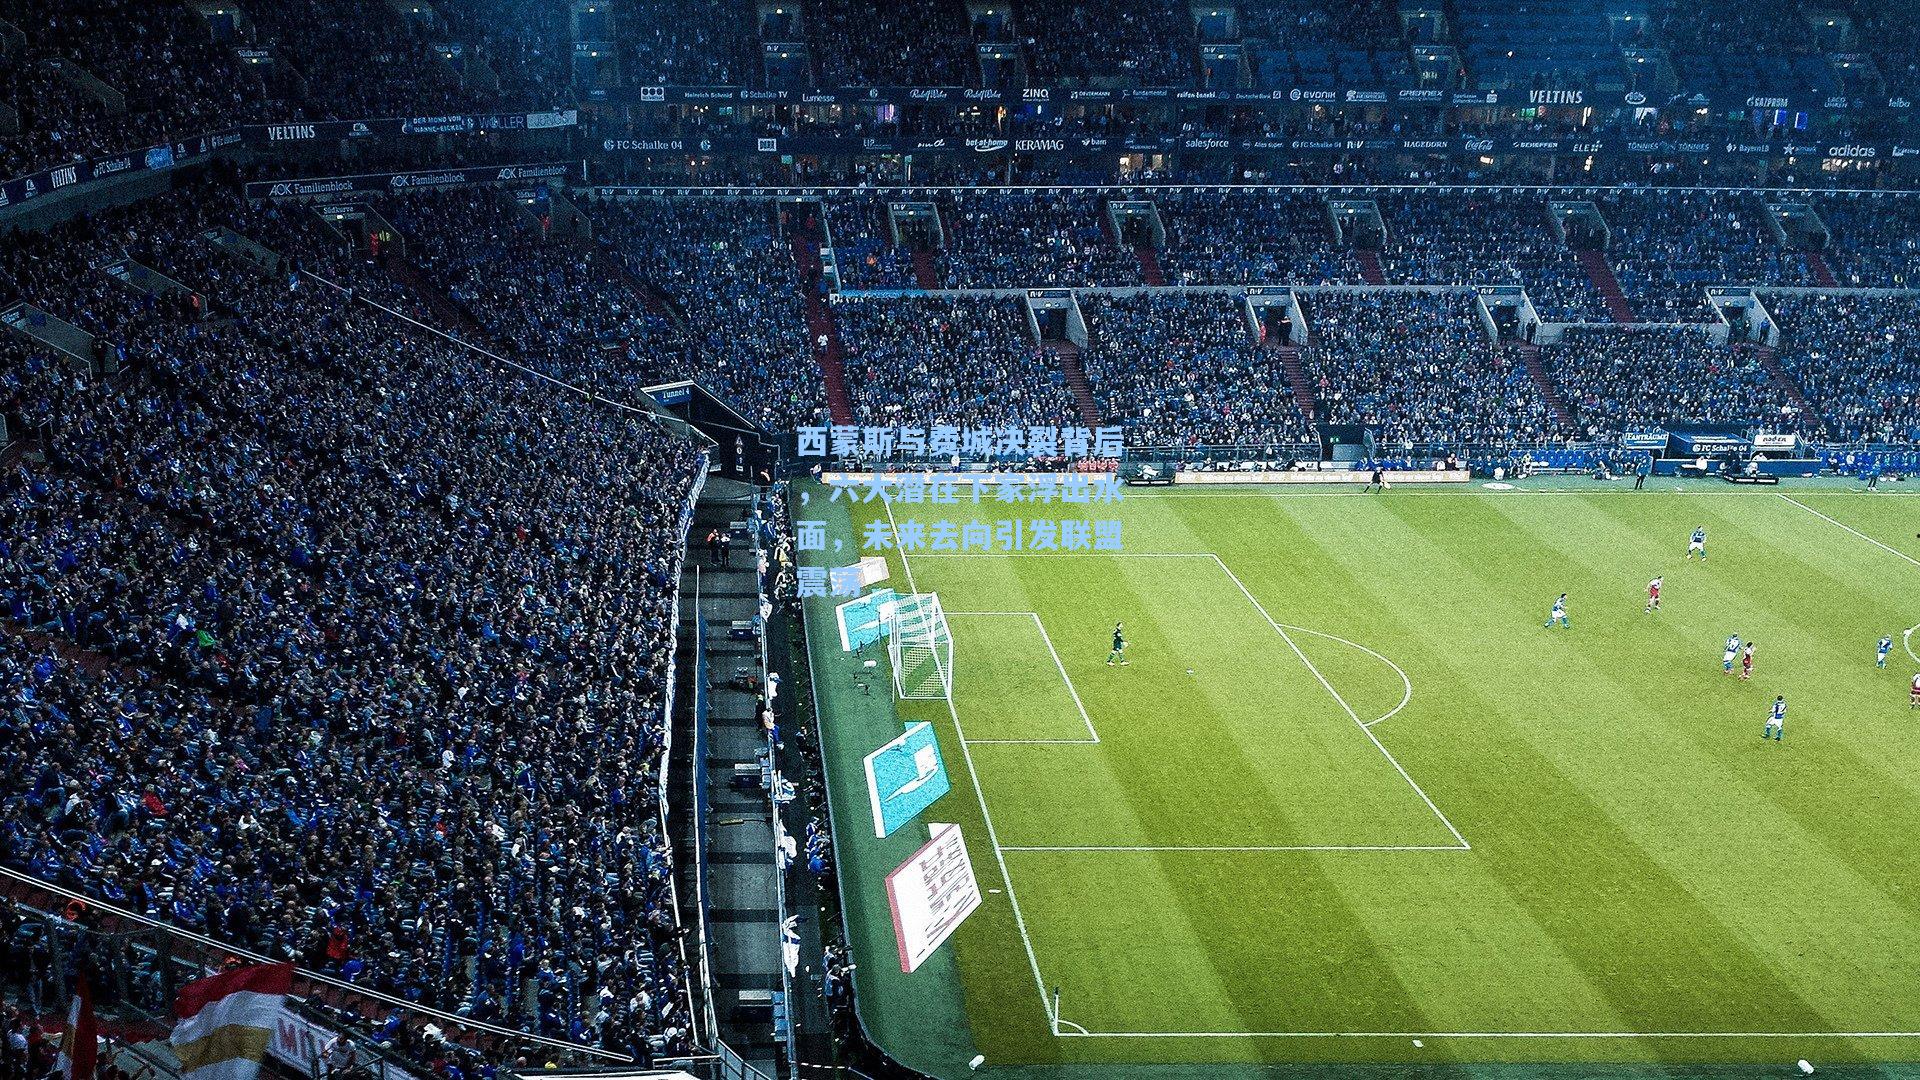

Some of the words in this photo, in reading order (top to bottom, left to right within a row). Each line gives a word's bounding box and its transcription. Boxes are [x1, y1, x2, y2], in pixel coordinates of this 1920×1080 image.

[1022, 88, 1049, 99] ZINQ
[1530, 90, 1583, 103] VELTINS
[268, 126, 316, 140] VELTINS
[617, 140, 629, 149] FC
[632, 140, 668, 149] Schalke
[671, 141, 682, 149] 04
[1015, 139, 1064, 151] KERAMAG
[1186, 138, 1229, 149] salesforce
[1573, 144, 1590, 152] ELE
[1829, 145, 1876, 157] adidas
[51, 166, 77, 188] VELTINS
[498, 167, 516, 180] AOK
[518, 166, 568, 178] Familienblock
[390, 175, 410, 187] AOK
[411, 173, 465, 186] Familienblock
[269, 183, 293, 196] AOK
[295, 180, 353, 194] Familienblock
[663, 389, 685, 399] Tunnel
[686, 387, 690, 395] 4
[1701, 444, 1711, 452] FC
